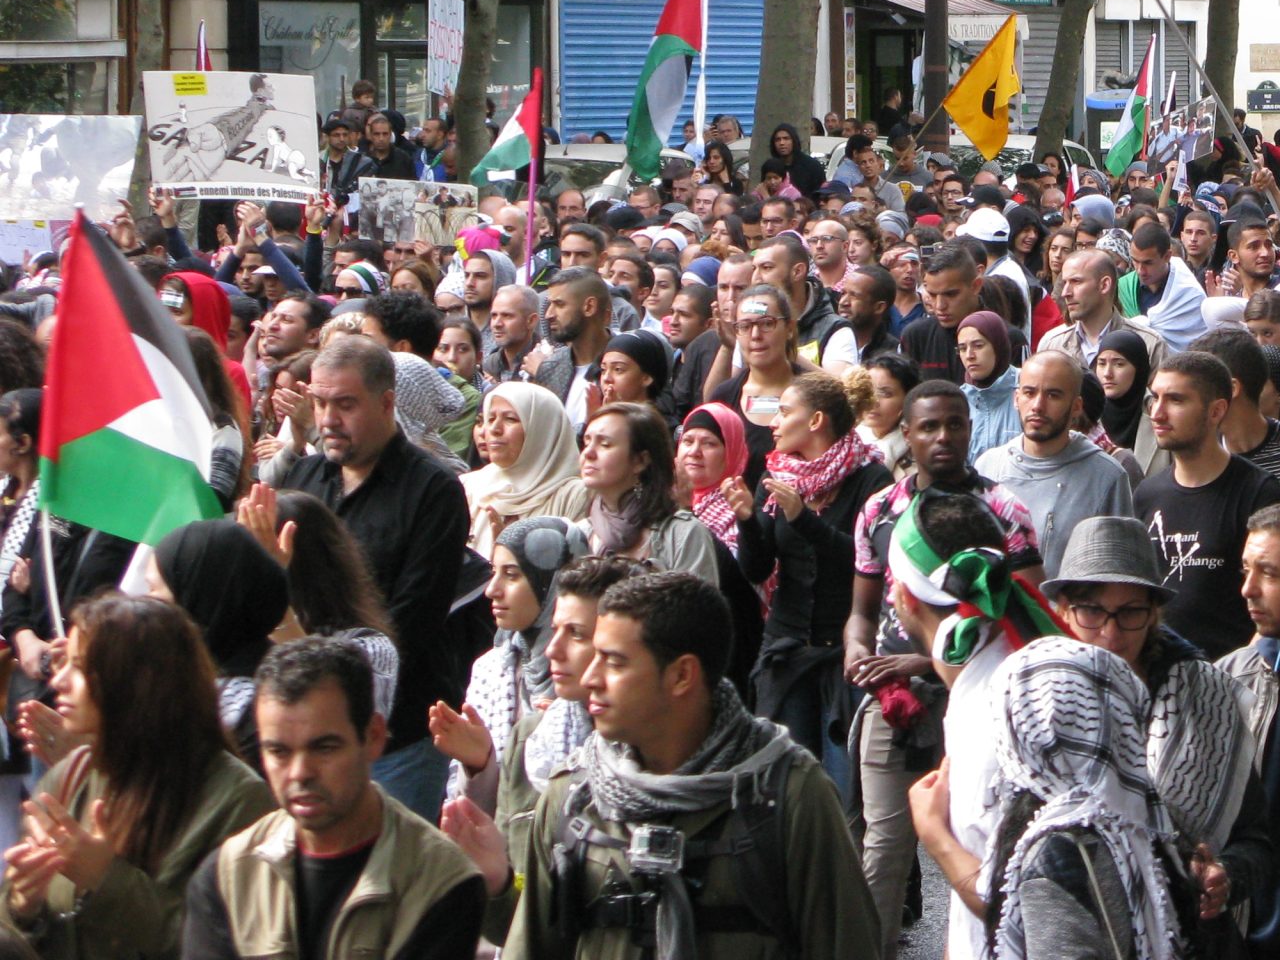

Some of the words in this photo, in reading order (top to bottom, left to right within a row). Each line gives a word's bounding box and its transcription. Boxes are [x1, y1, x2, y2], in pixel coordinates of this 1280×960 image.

[200, 185, 228, 196] ennemi
[230, 186, 255, 197] intime
[257, 186, 271, 197] des
[272, 187, 308, 201] Palestinie
